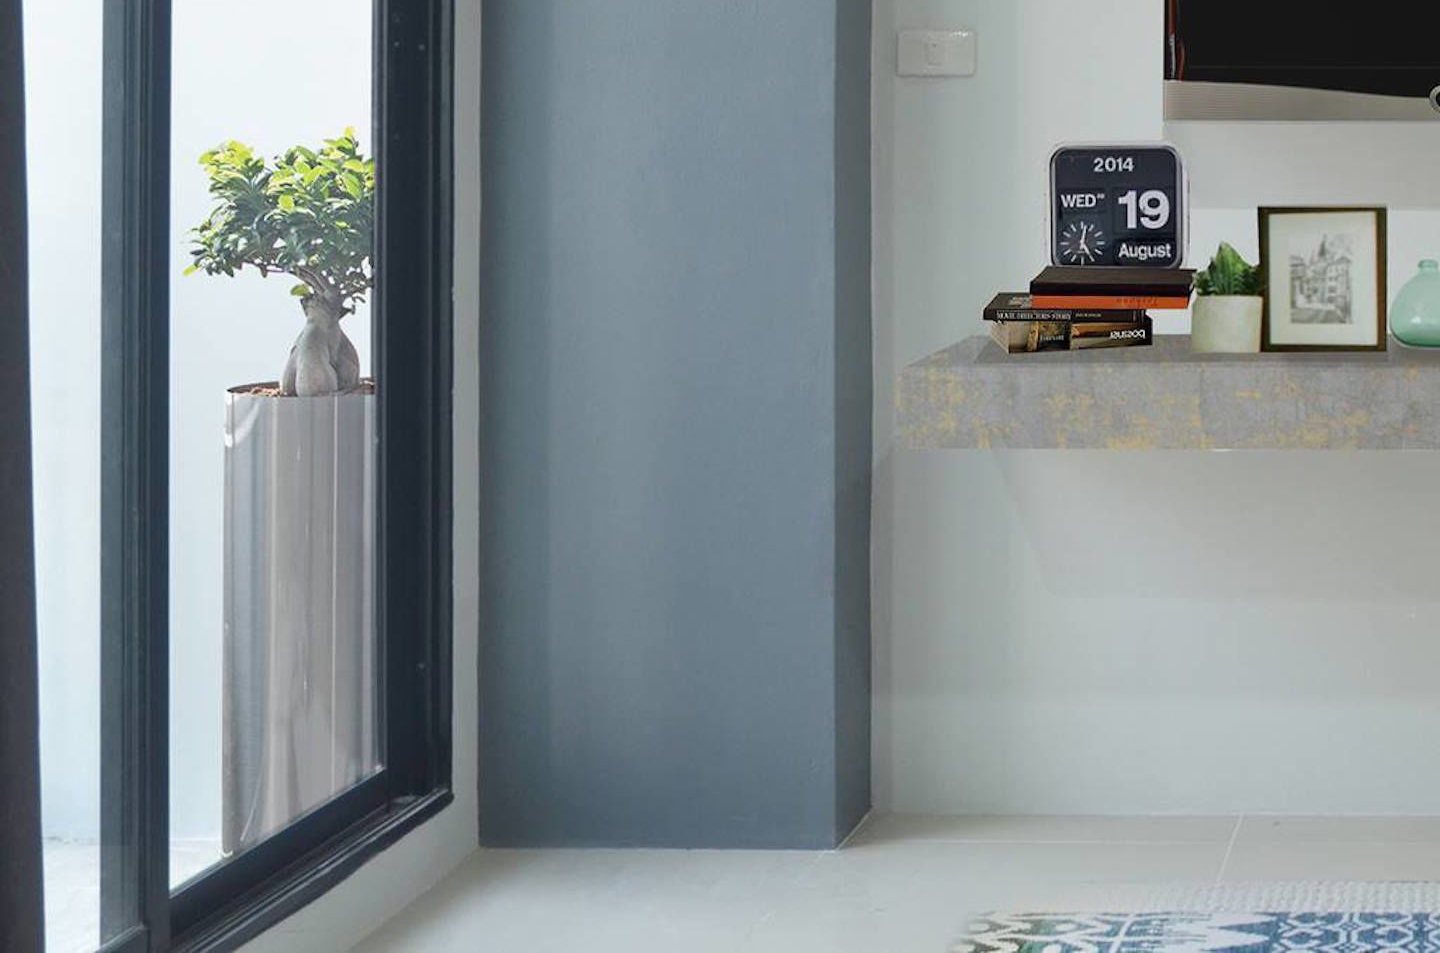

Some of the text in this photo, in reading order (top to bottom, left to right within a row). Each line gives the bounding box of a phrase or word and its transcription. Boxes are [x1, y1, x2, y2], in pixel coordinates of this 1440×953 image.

[1093, 157, 1135, 173] 2014
[1060, 193, 1097, 208] WED
[1118, 189, 1170, 230] 19
[1118, 242, 1172, 260] August
